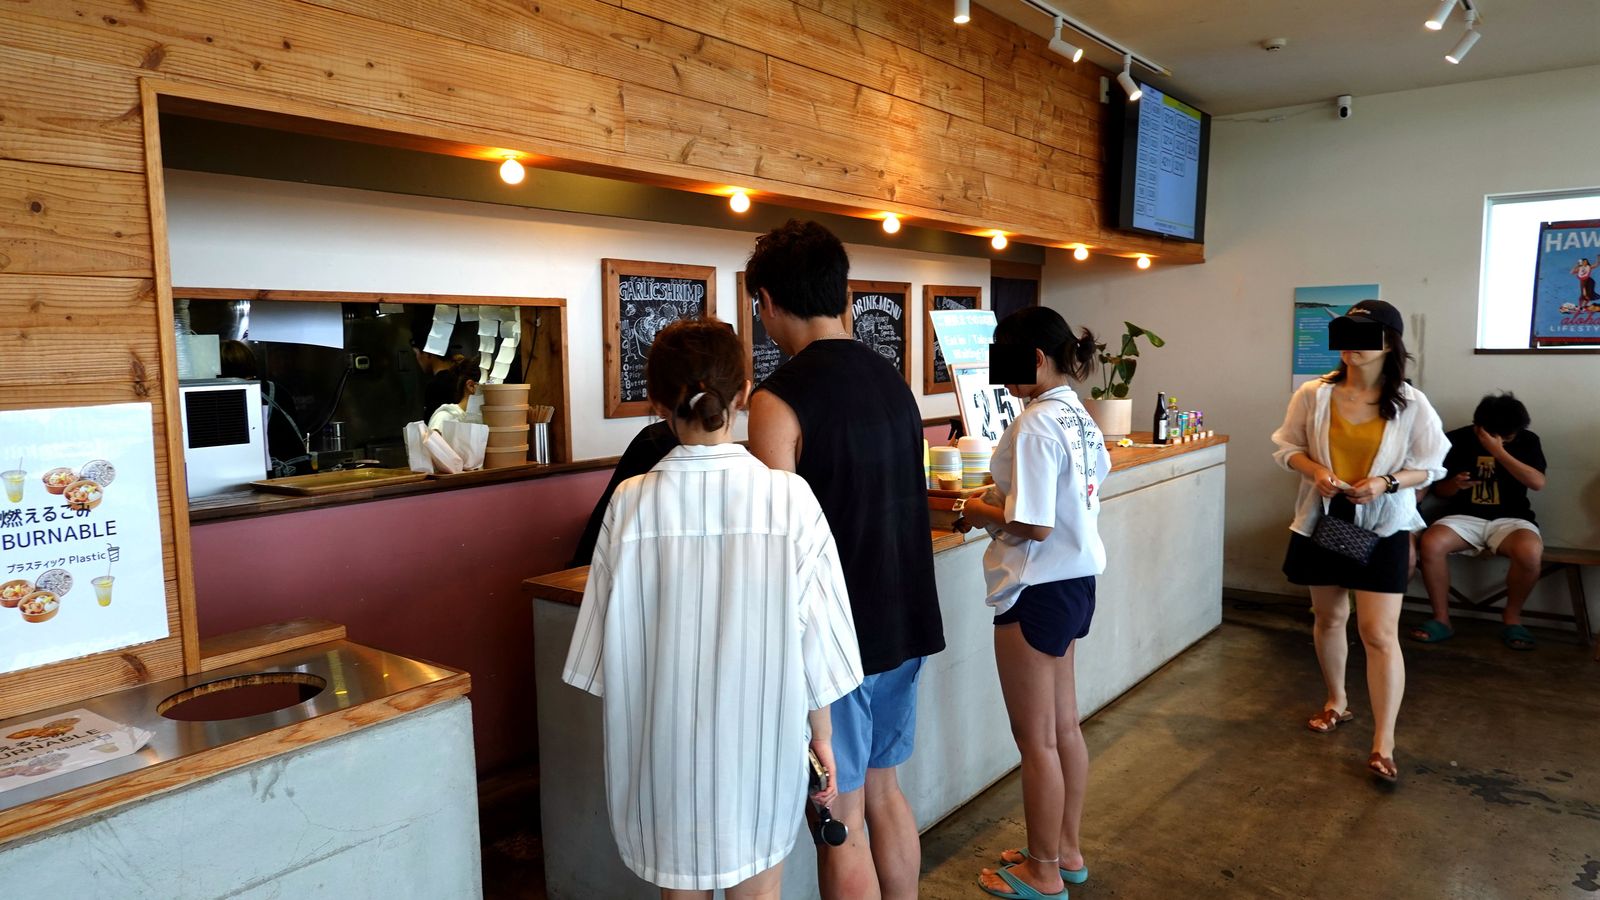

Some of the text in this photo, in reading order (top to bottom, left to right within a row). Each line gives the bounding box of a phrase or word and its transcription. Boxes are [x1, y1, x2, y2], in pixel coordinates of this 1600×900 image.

[619, 281, 704, 303] GARLIC SHRIMP
[851, 295, 903, 321] DRINK MENU
[0, 503, 91, 529] 燃えるごみ
[2, 520, 118, 551] BURNABLE
[7, 551, 107, 574] プラスティック Plastic
